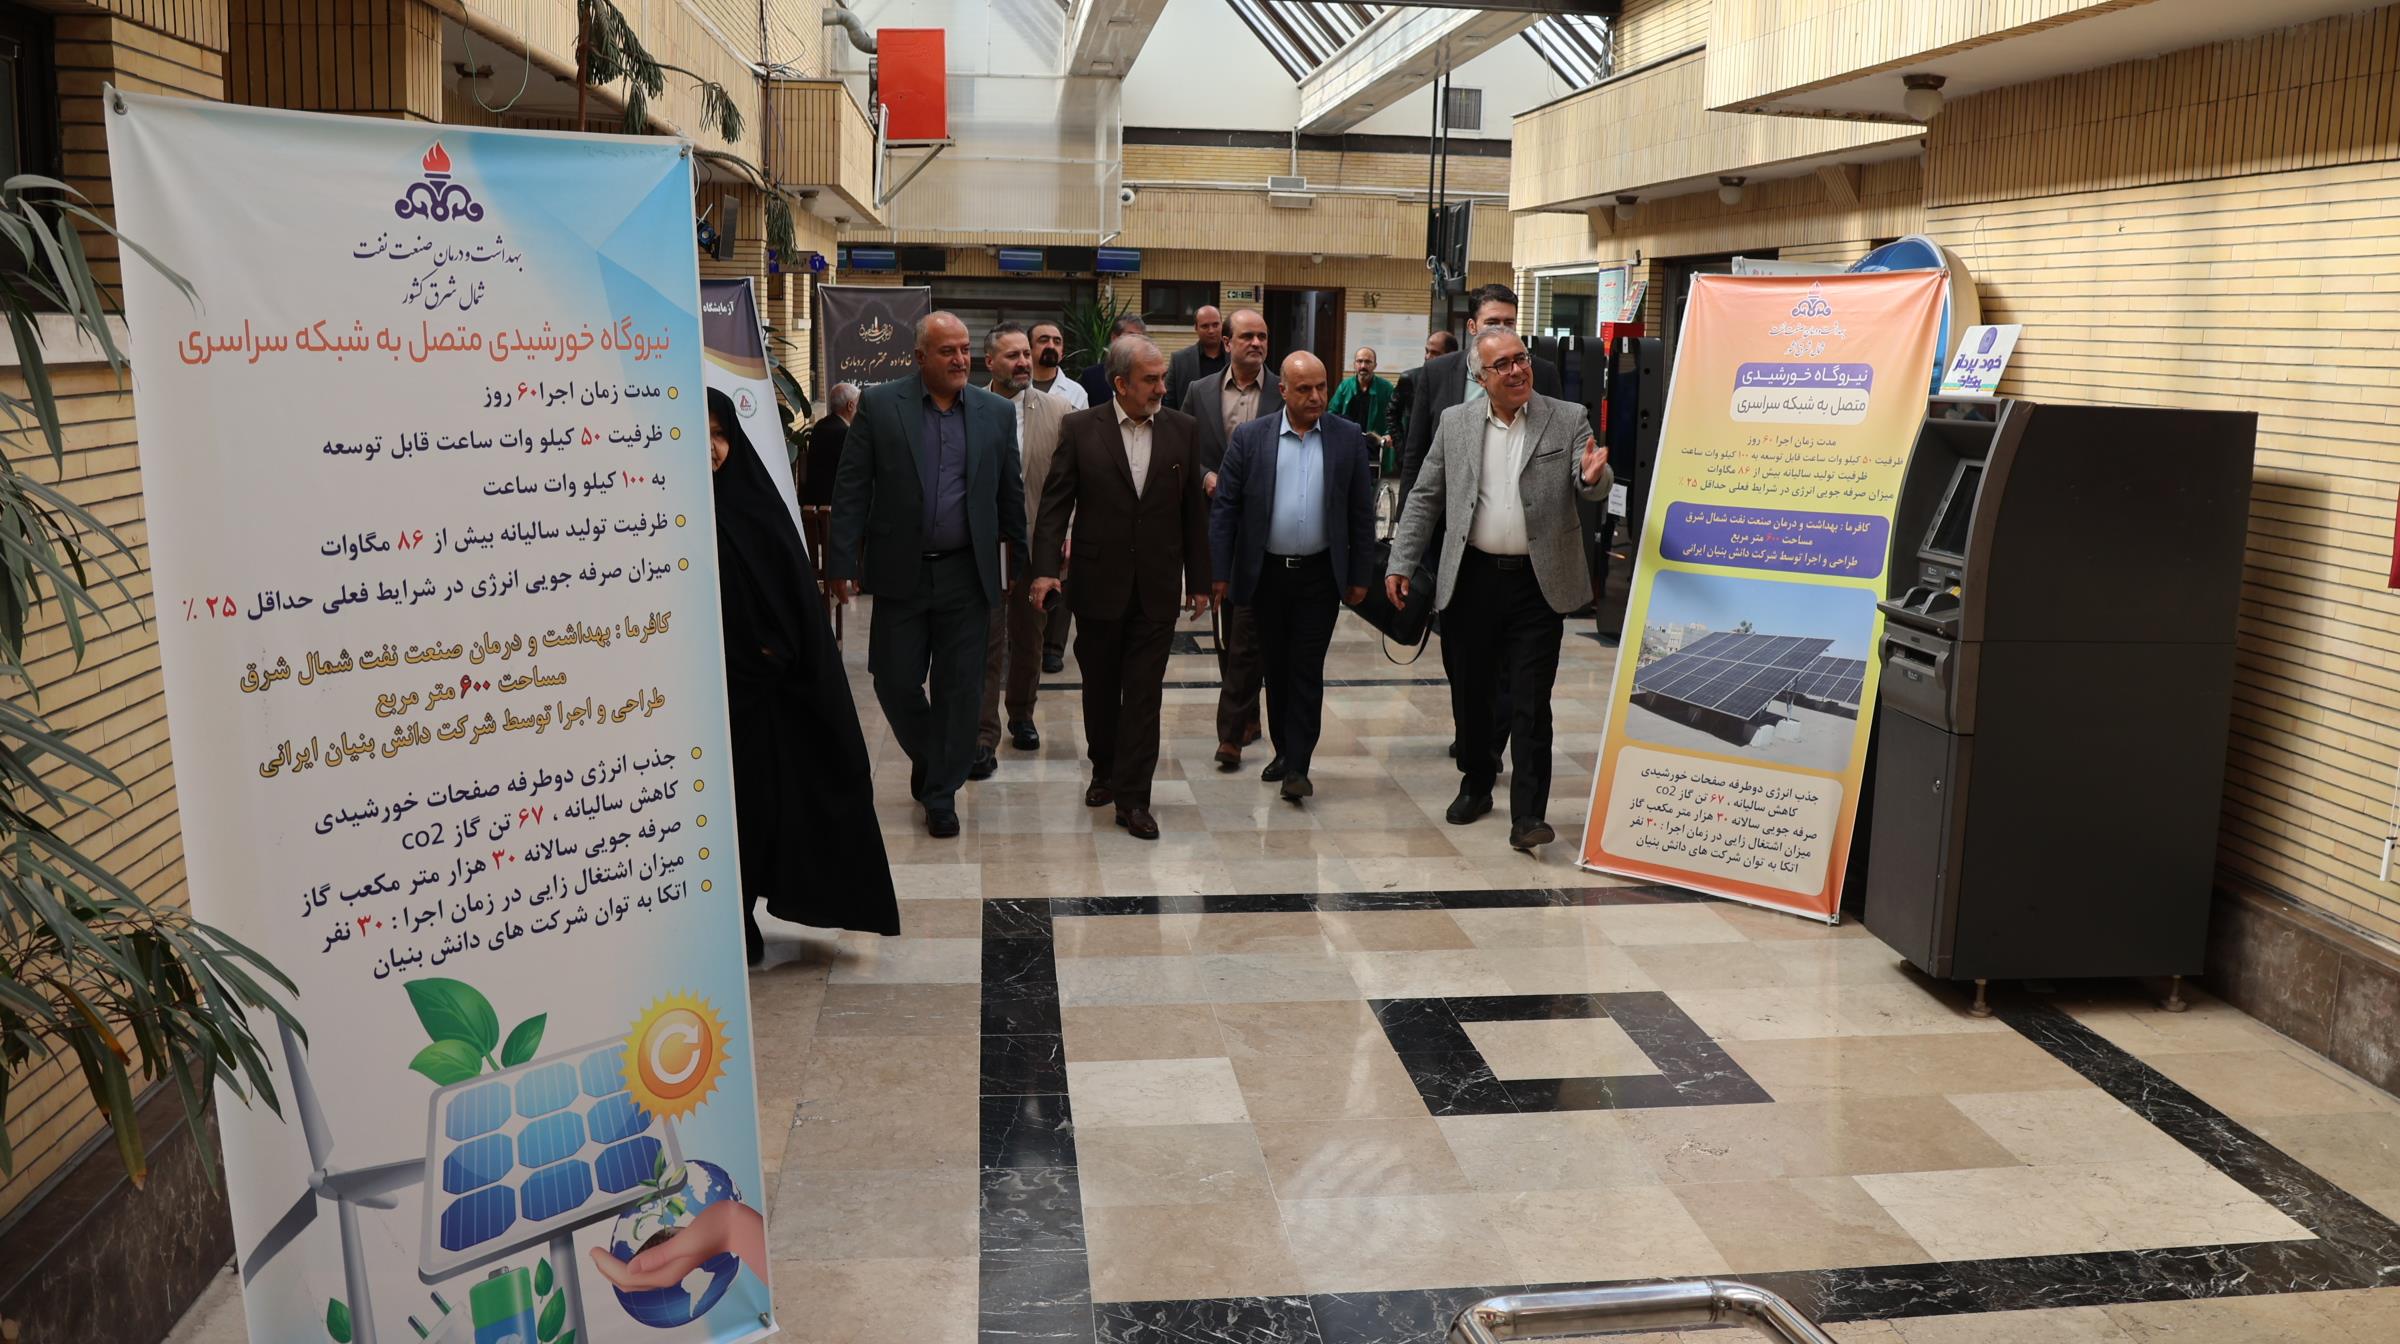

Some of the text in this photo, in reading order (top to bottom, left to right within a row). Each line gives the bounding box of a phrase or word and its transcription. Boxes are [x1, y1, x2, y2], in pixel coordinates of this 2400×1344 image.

[353, 232, 523, 272] بهداشت و درمان صنعت نفت
[403, 268, 485, 311] شمال شرق کشور
[179, 316, 669, 364] نیروگاه خورشیدی متصل به شبکه سراسری
[1742, 365, 1867, 386] نیروگاه خورشیدی
[483, 387, 512, 408] روز
[581, 381, 618, 406] زمان
[624, 385, 660, 398] مدت
[1737, 394, 1866, 416] متصل به شبکه سراسری
[323, 424, 662, 461] ظرفیت ۵۰ کیلو وات ساعت قابل توسعه
[483, 471, 665, 497] به ۱۰۰ کیلو وات ساعت
[321, 512, 668, 561] ظرفیت تولید سالیانه بیش از ۸۶ مگاوات
[579, 562, 622, 586] صرفه
[629, 557, 671, 583] میزان
[377, 578, 436, 605] شرایط
[444, 580, 463, 601] در
[471, 569, 518, 598] انرژی
[526, 572, 572, 594] جویی
[206, 595, 237, 618] ۲۵
[248, 590, 313, 621] حداقل
[323, 582, 368, 614] فعلی
[542, 621, 611, 648] بهداشت
[624, 611, 671, 644] کافرما
[359, 644, 399, 670] نفت
[404, 641, 463, 664] صنعت
[469, 632, 522, 665] درمان
[528, 636, 538, 657] و
[240, 656, 291, 693] شرق
[298, 649, 353, 686] شمال
[375, 665, 567, 718] مساحت ۶۰۰ متر مربع
[259, 687, 665, 778] طراحی و اجرا توسط شرکت دانش بنیان ایرانی
[581, 754, 626, 787] انرژی
[633, 749, 676, 776] جذب
[1641, 768, 1687, 783] خورشیدی
[1691, 774, 1725, 786] صفحات
[427, 780, 500, 807] صفحات
[630, 779, 678, 814] کاهش
[1678, 789, 1694, 801] گاز
[1695, 793, 1708, 804] تن
[1710, 794, 1724, 804] ۶۷
[1734, 799, 1765, 812] سالیانه
[1766, 788, 1792, 800] انرژی
[1795, 792, 1818, 802] جذب
[315, 792, 418, 835] خورشیدی
[519, 805, 543, 829] ۶۷
[565, 793, 623, 820] سالیانه
[1768, 805, 1798, 817] کاهش
[454, 816, 480, 848] گاز
[489, 813, 511, 841] تن
[1629, 798, 1817, 841] صرفه جویی سالانه ۳۰ هزار متر مکعب گاز
[1630, 816, 1644, 827] نفر
[1666, 821, 1685, 835] اجرا
[1636, 835, 1659, 848] بنیان
[1662, 840, 1686, 852] دانش
[1686, 826, 1708, 841] زمان
[1710, 833, 1722, 843] در
[1724, 834, 1746, 848] زایی
[1748, 837, 1783, 851] اشتغال
[1689, 845, 1707, 857] های
[1711, 850, 1741, 863] شرکت
[1743, 856, 1765, 869] توان
[1784, 844, 1811, 859] میزان
[301, 819, 681, 917] صرفه جویی سالانه ۳۰ هزار متر مکعب گاز
[575, 858, 632, 895] اشتغال
[639, 853, 684, 881] میزان
[1780, 860, 1798, 872] اتکا
[501, 888, 521, 912] در
[529, 874, 567, 906] زایی
[403, 899, 443, 933] اجرا
[451, 893, 494, 924] زمان
[322, 922, 350, 953] نفر
[357, 915, 382, 937] ۳۰
[374, 880, 686, 979] اتکا به توان شرکت های دانش بنیان
